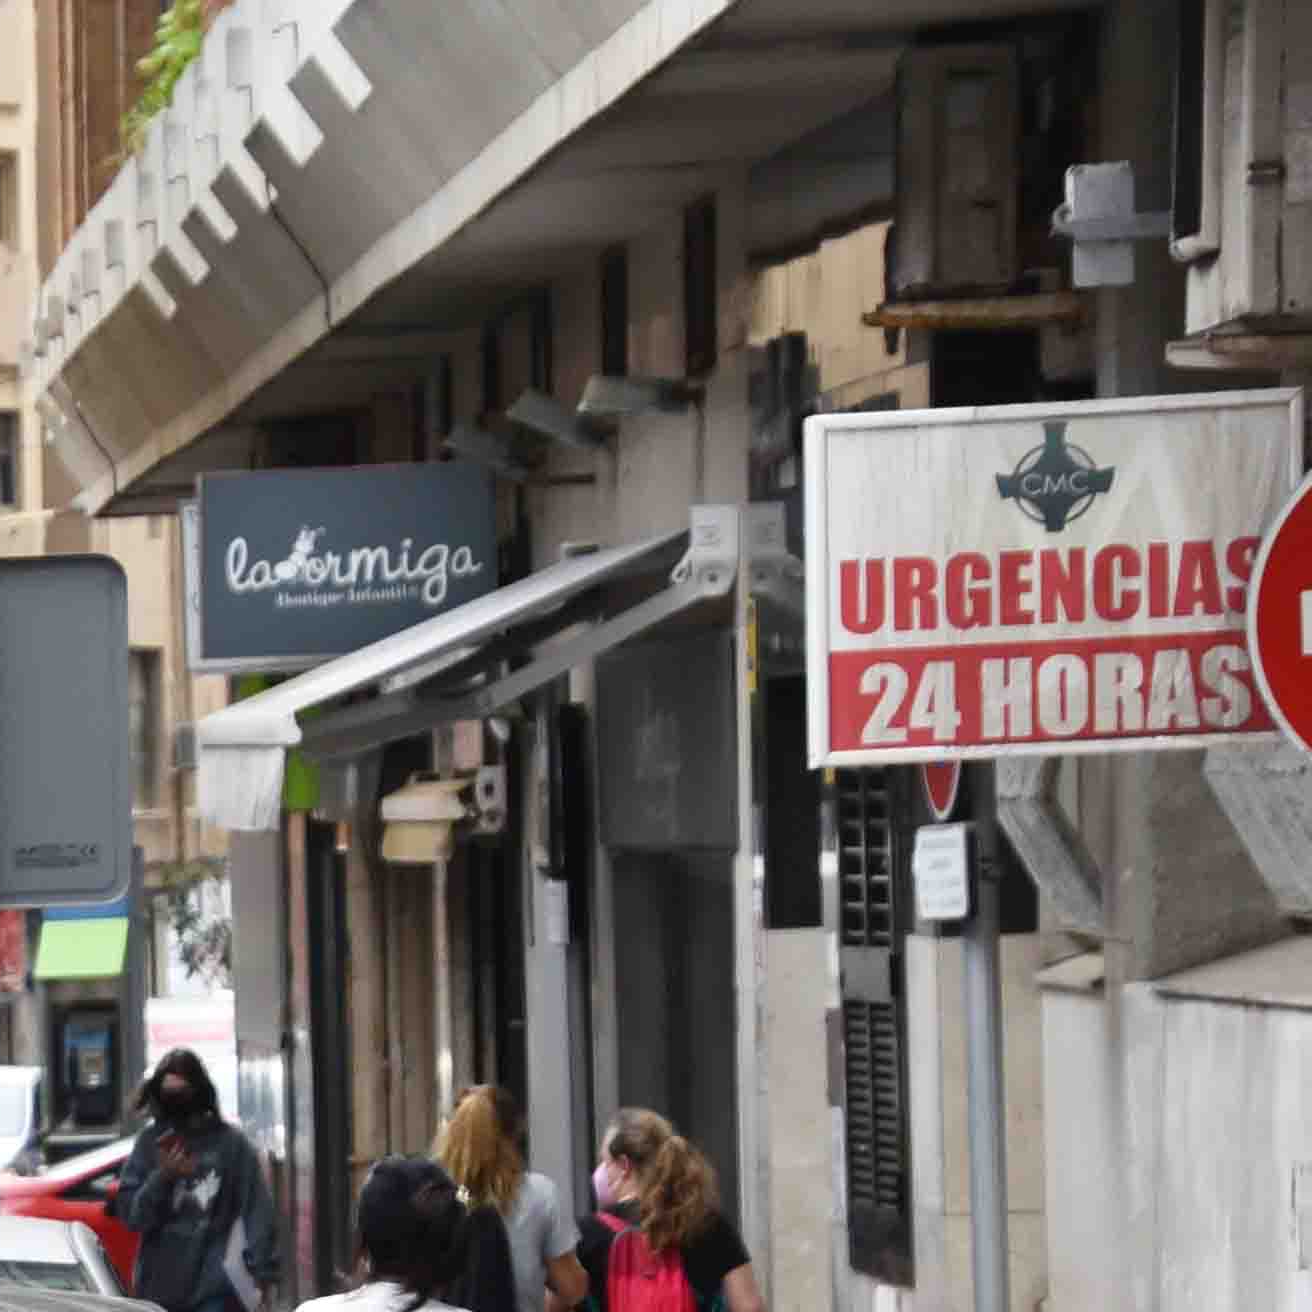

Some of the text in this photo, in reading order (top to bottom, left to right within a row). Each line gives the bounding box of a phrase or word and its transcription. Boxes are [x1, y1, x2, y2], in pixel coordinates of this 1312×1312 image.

[1021, 471, 1091, 496] CMC
[839, 536, 1262, 634] URGENCIAS
[859, 643, 1252, 745] 24 HORAS
